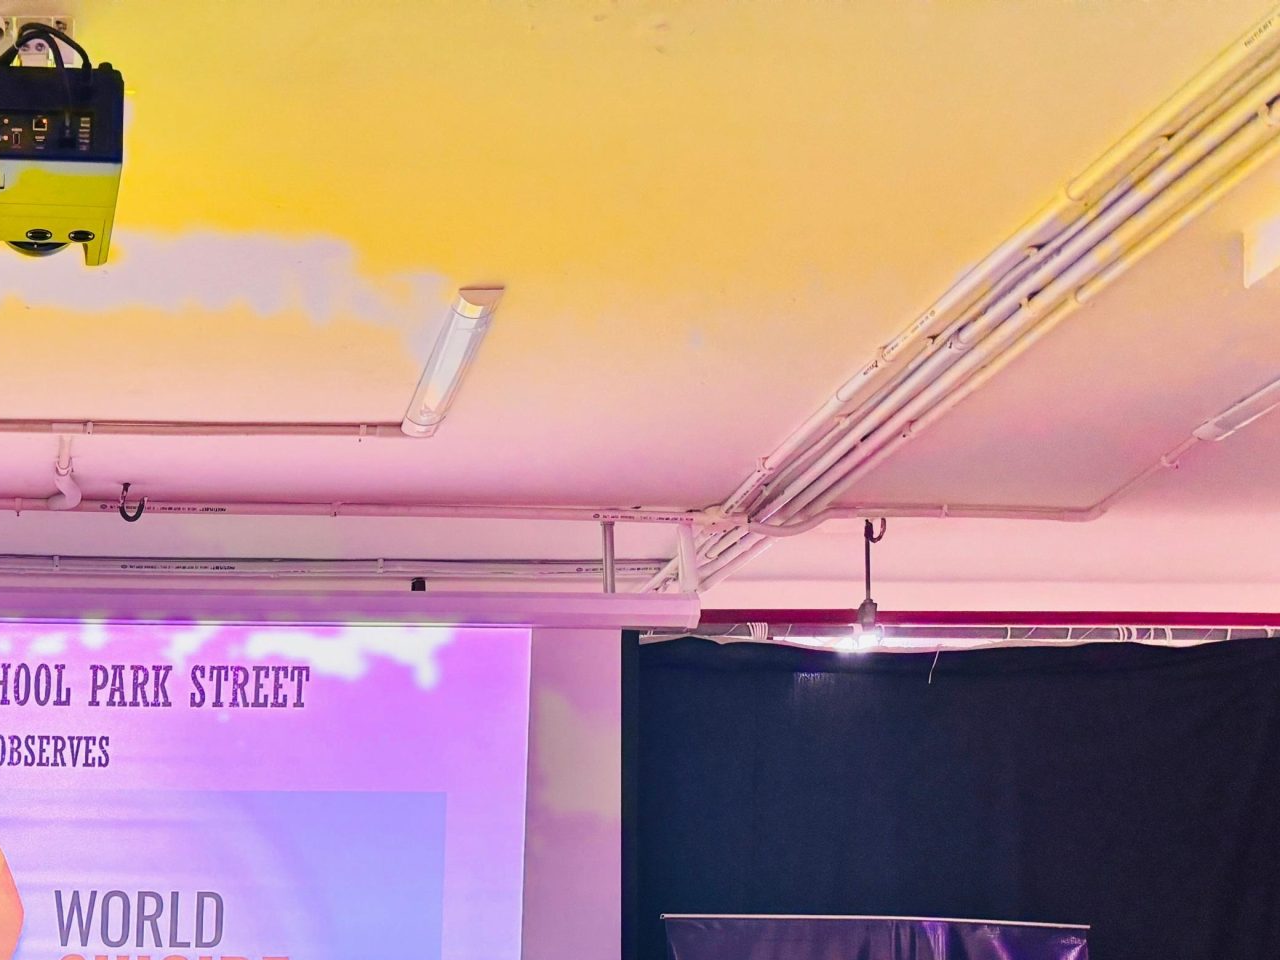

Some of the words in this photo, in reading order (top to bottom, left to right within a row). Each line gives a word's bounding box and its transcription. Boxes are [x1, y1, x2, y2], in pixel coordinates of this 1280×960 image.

[87, 664, 174, 709] PARK
[189, 664, 310, 709] STREET
[54, 889, 224, 949] WORLD
